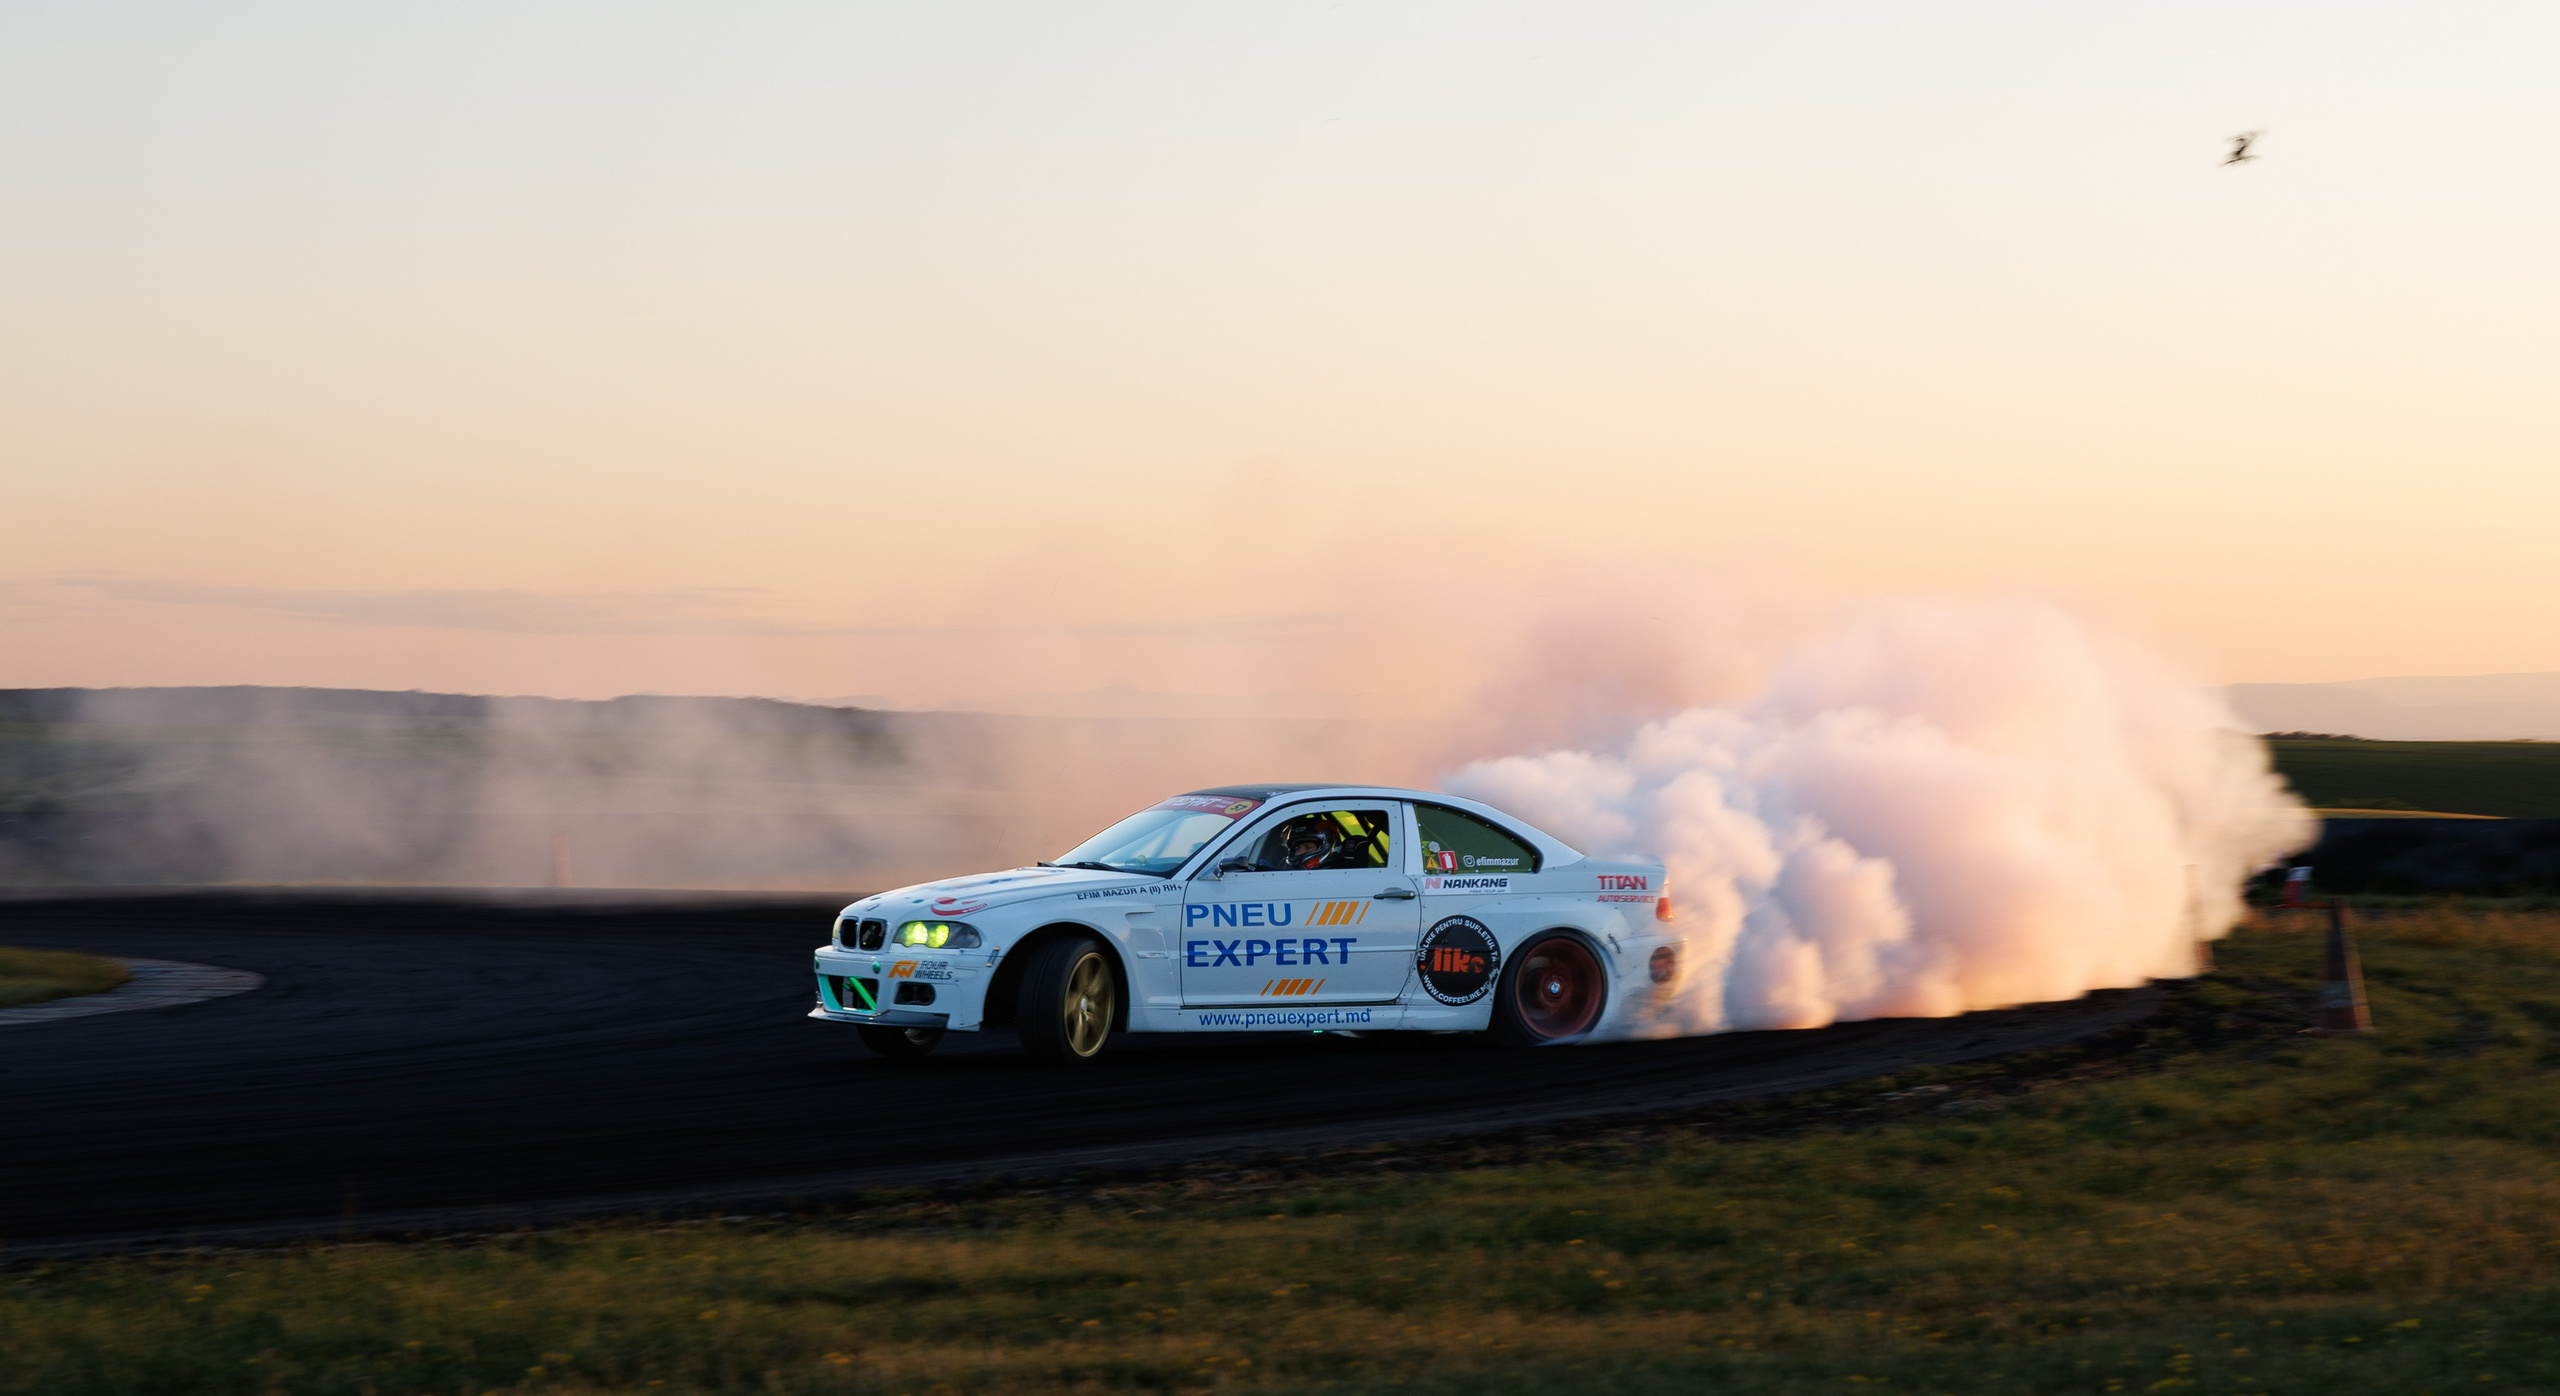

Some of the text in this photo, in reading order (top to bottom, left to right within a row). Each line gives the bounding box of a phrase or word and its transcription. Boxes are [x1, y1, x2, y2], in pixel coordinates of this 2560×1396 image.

[1476, 856, 1519, 867] efimmazur
[1077, 890, 1101, 901] EFIM
[1103, 886, 1138, 898] MAZUR
[1140, 886, 1147, 894] A
[1163, 883, 1182, 892] RH+
[1443, 878, 1508, 889] NANKANG
[1186, 903, 1292, 927] PNEU
[1420, 948, 1428, 961] UN
[1424, 931, 1437, 948] LIKE
[1435, 918, 1463, 934] PENTRU
[1464, 919, 1496, 950] SUFLETUL
[1187, 938, 1357, 967] EXPERT
[1433, 947, 1485, 973] like
[920, 960, 949, 970] FOUR
[915, 970, 953, 980] WHEELS
[1199, 1008, 1371, 1028] www.pneuexpert.md
